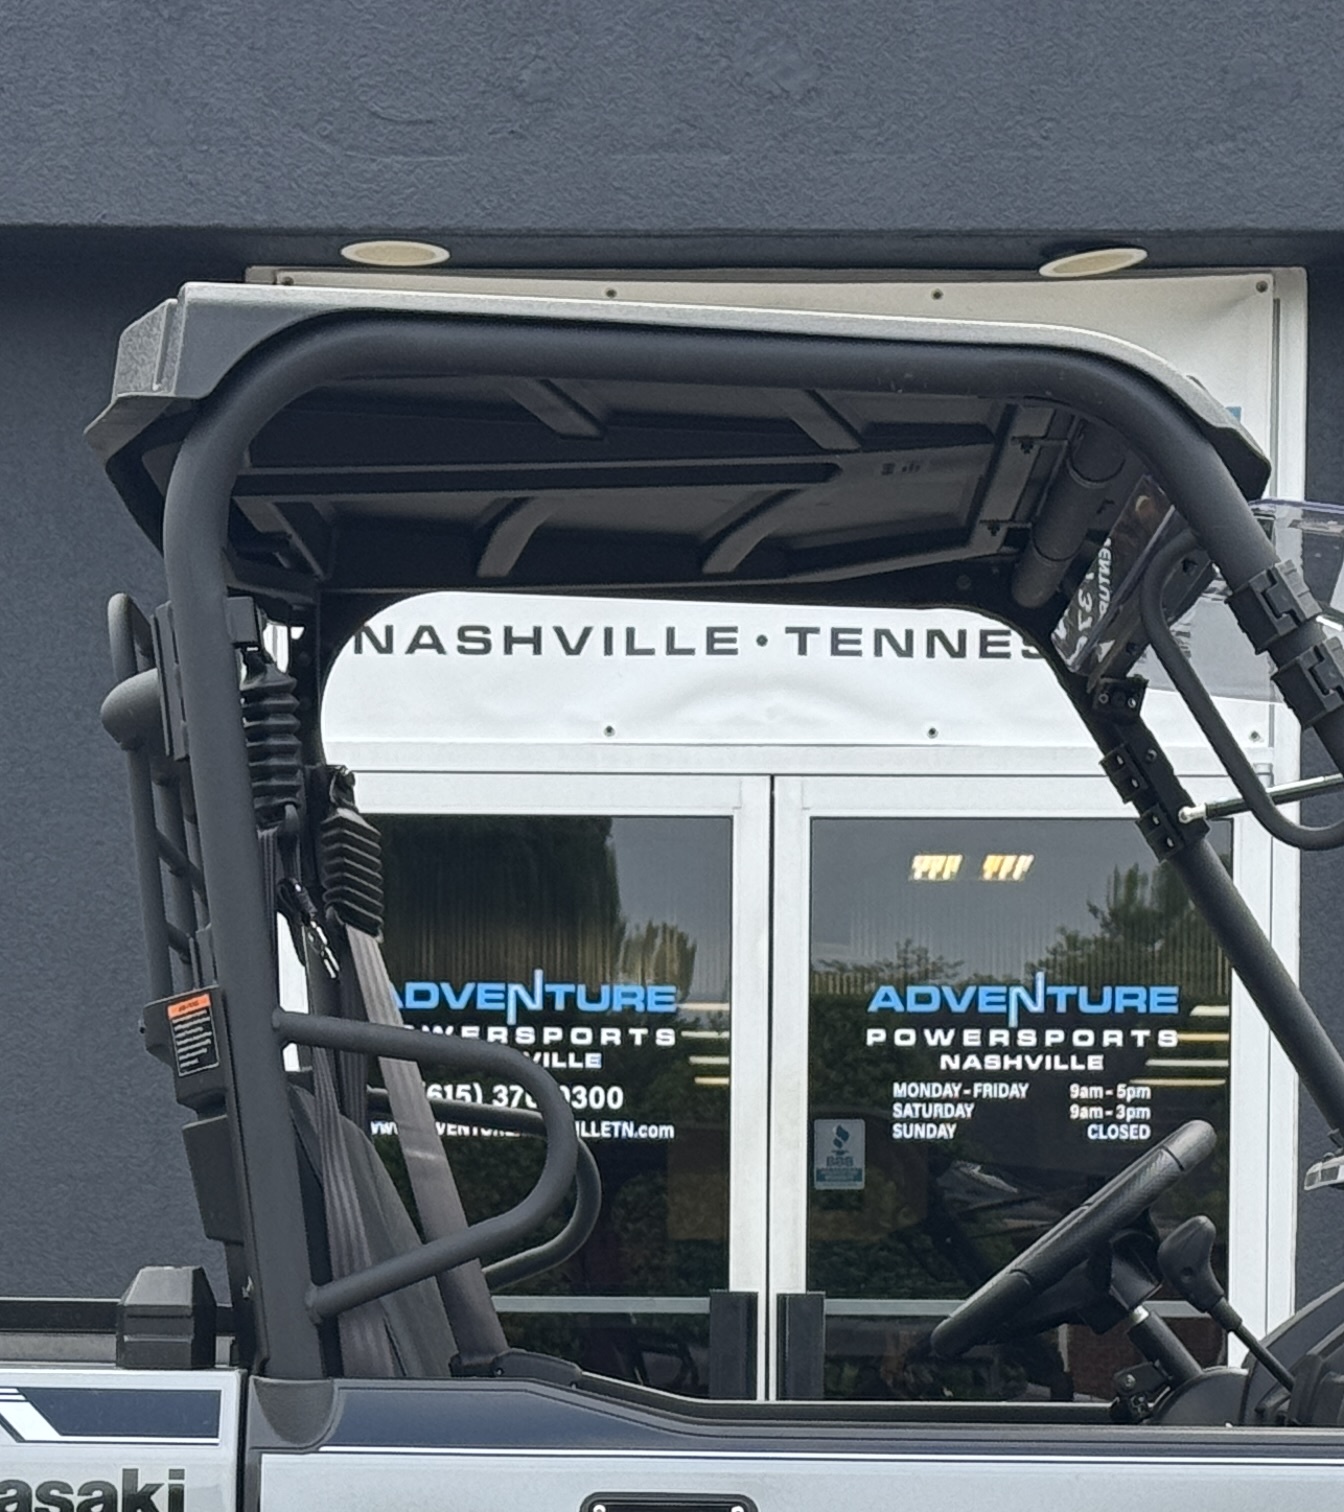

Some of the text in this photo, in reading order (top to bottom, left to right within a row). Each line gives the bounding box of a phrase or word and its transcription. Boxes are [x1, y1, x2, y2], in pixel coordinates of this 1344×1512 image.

[354, 624, 739, 656] NASHVILLE
[391, 968, 677, 1025] DVENTURE
[867, 971, 1180, 1028] ADVENTURE
[866, 1028, 1179, 1048] POWERSPORTS
[939, 1054, 1104, 1071] NASHVILLE
[892, 1103, 975, 1119] SATURDAY
[892, 1123, 957, 1139] SUNDAY
[1087, 1123, 1152, 1140] CLOSED
